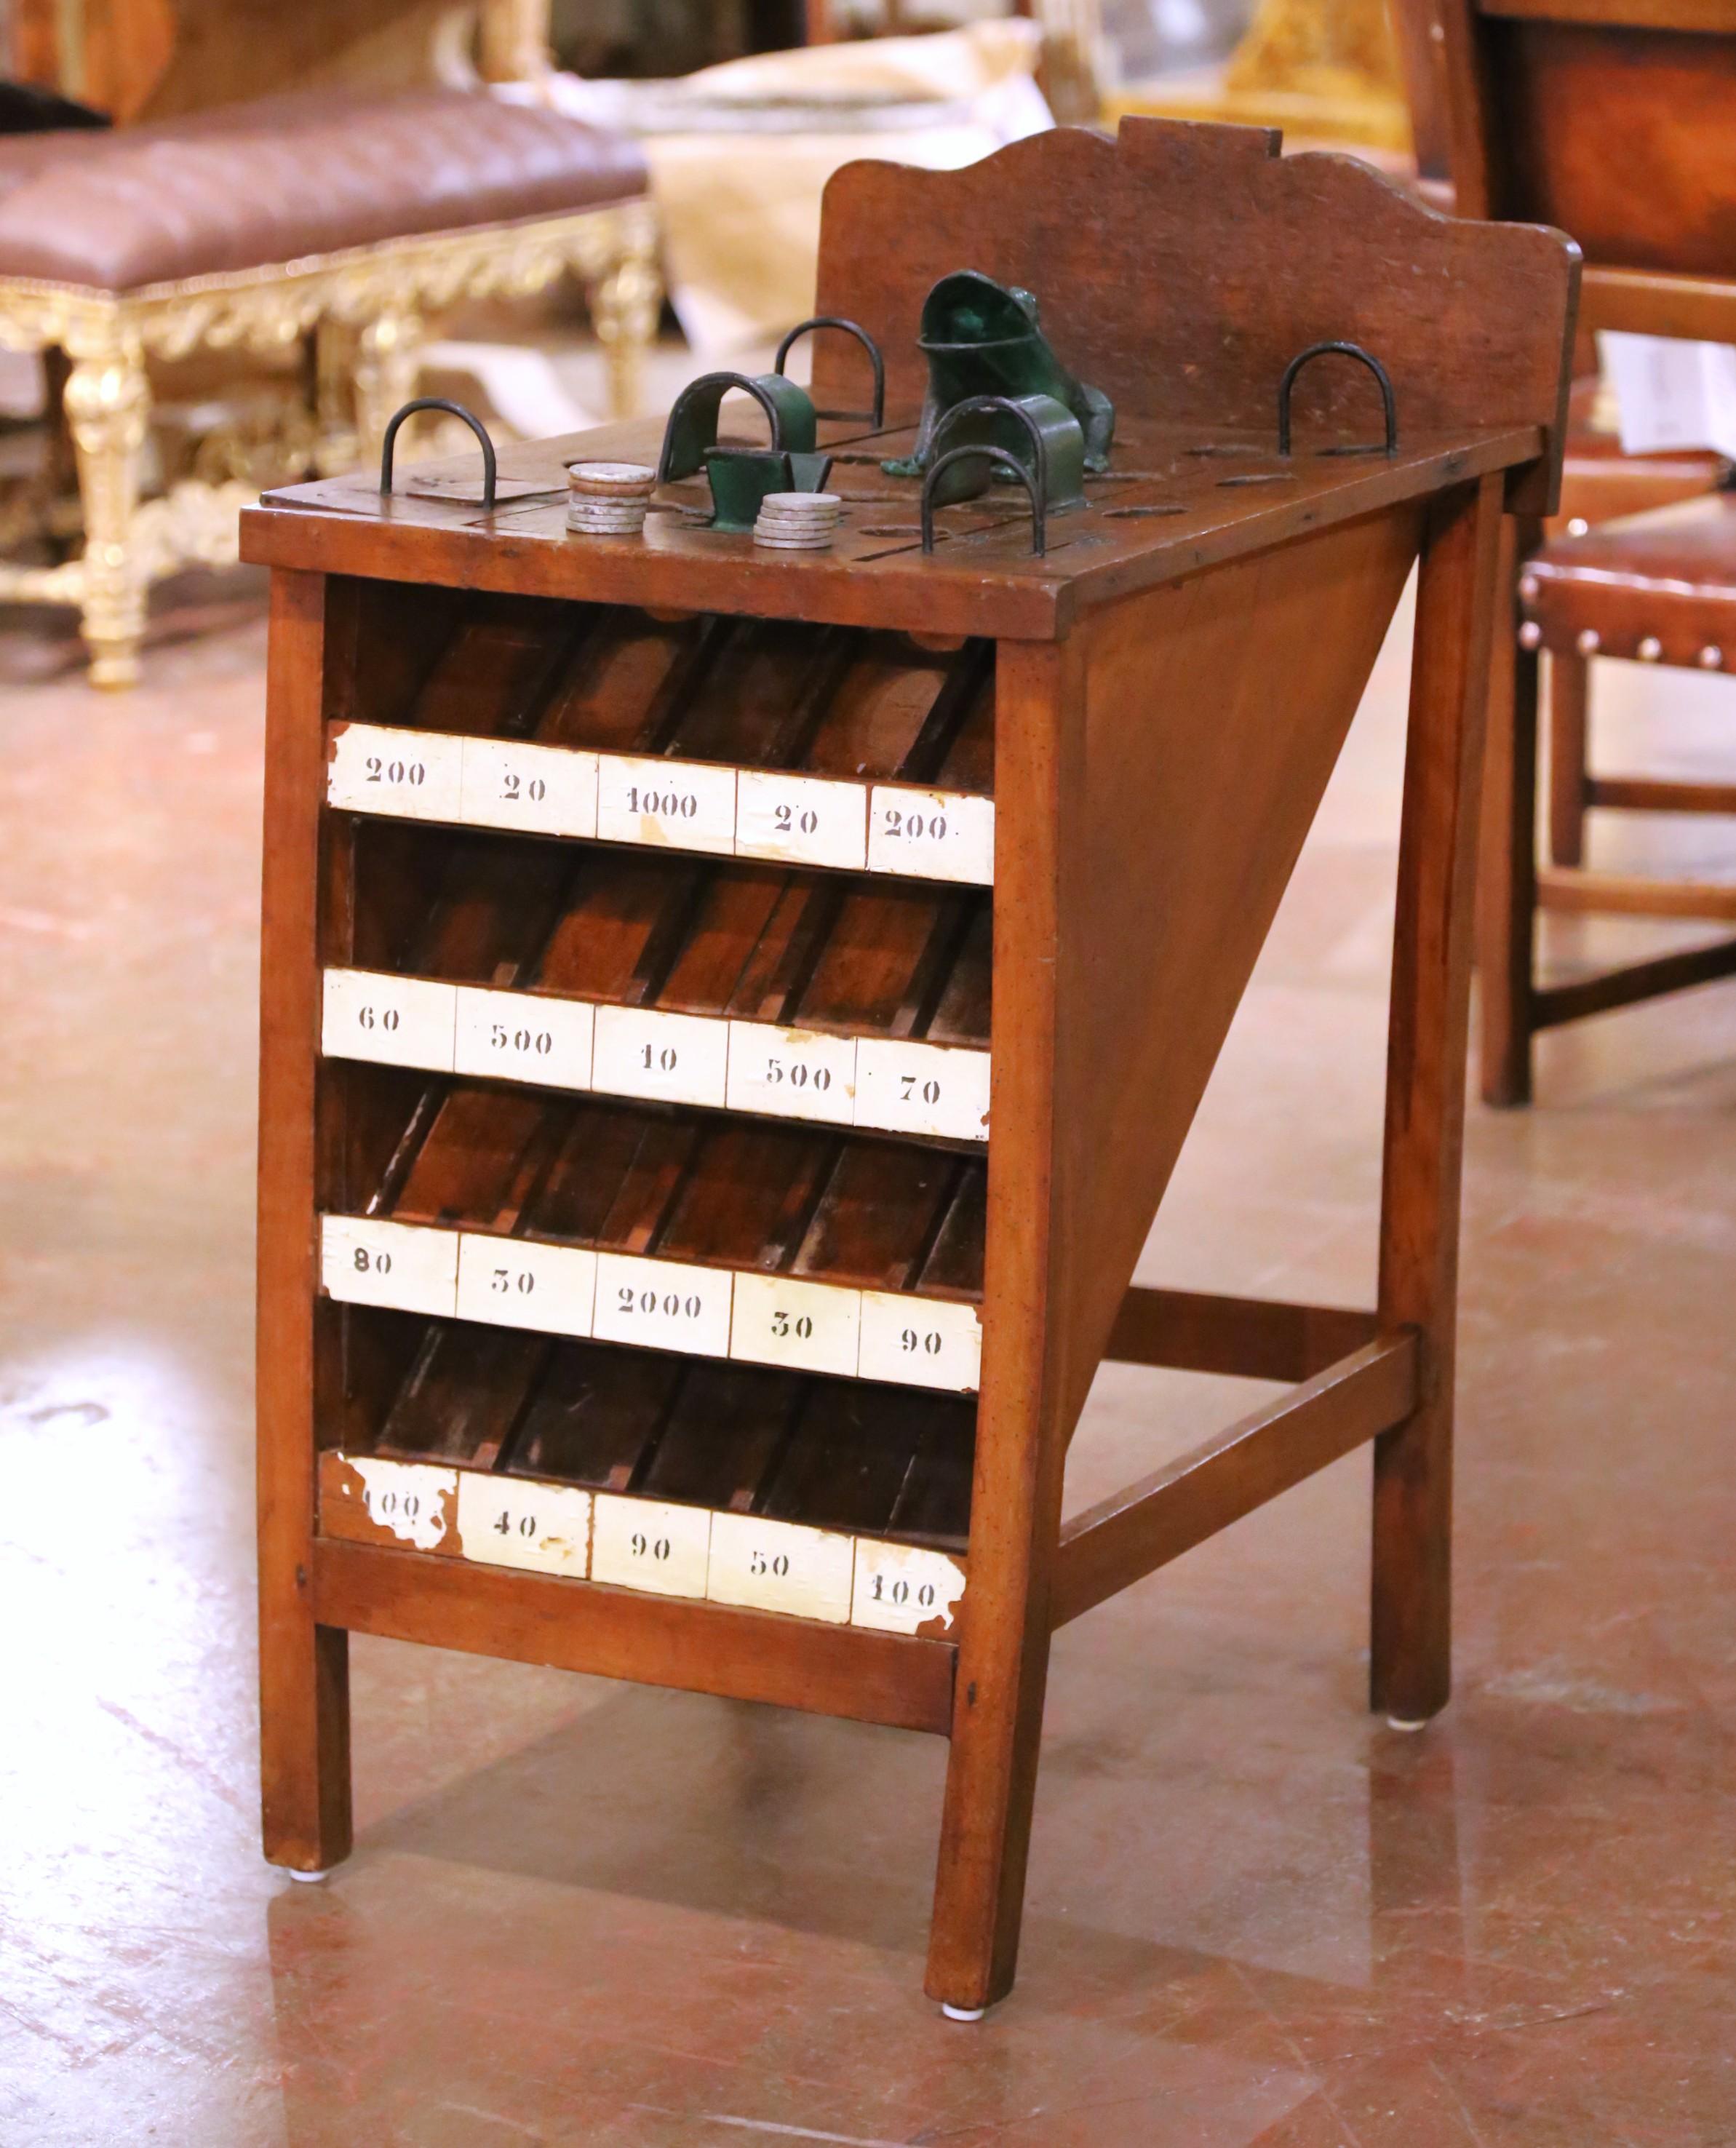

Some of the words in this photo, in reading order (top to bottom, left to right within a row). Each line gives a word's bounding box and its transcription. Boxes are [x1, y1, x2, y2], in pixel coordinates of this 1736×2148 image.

[366, 757, 425, 786] 200
[503, 774, 546, 801] 20
[626, 787, 697, 818] 1000
[774, 805, 818, 834] 20
[884, 810, 947, 840] 200
[359, 1007, 399, 1031] 60
[491, 1025, 552, 1054] 500
[643, 1043, 677, 1071] 10
[766, 1059, 831, 1091] 500
[900, 1075, 941, 1105] 70
[354, 1247, 391, 1274] 80
[491, 1269, 535, 1294] 30
[618, 1288, 701, 1318] 2000
[771, 1311, 813, 1339] 30
[901, 1329, 942, 1355] 90
[493, 1511, 536, 1538] 40
[632, 1534, 670, 1560] 90
[750, 1551, 789, 1577] 50
[872, 1575, 935, 1607] 100
